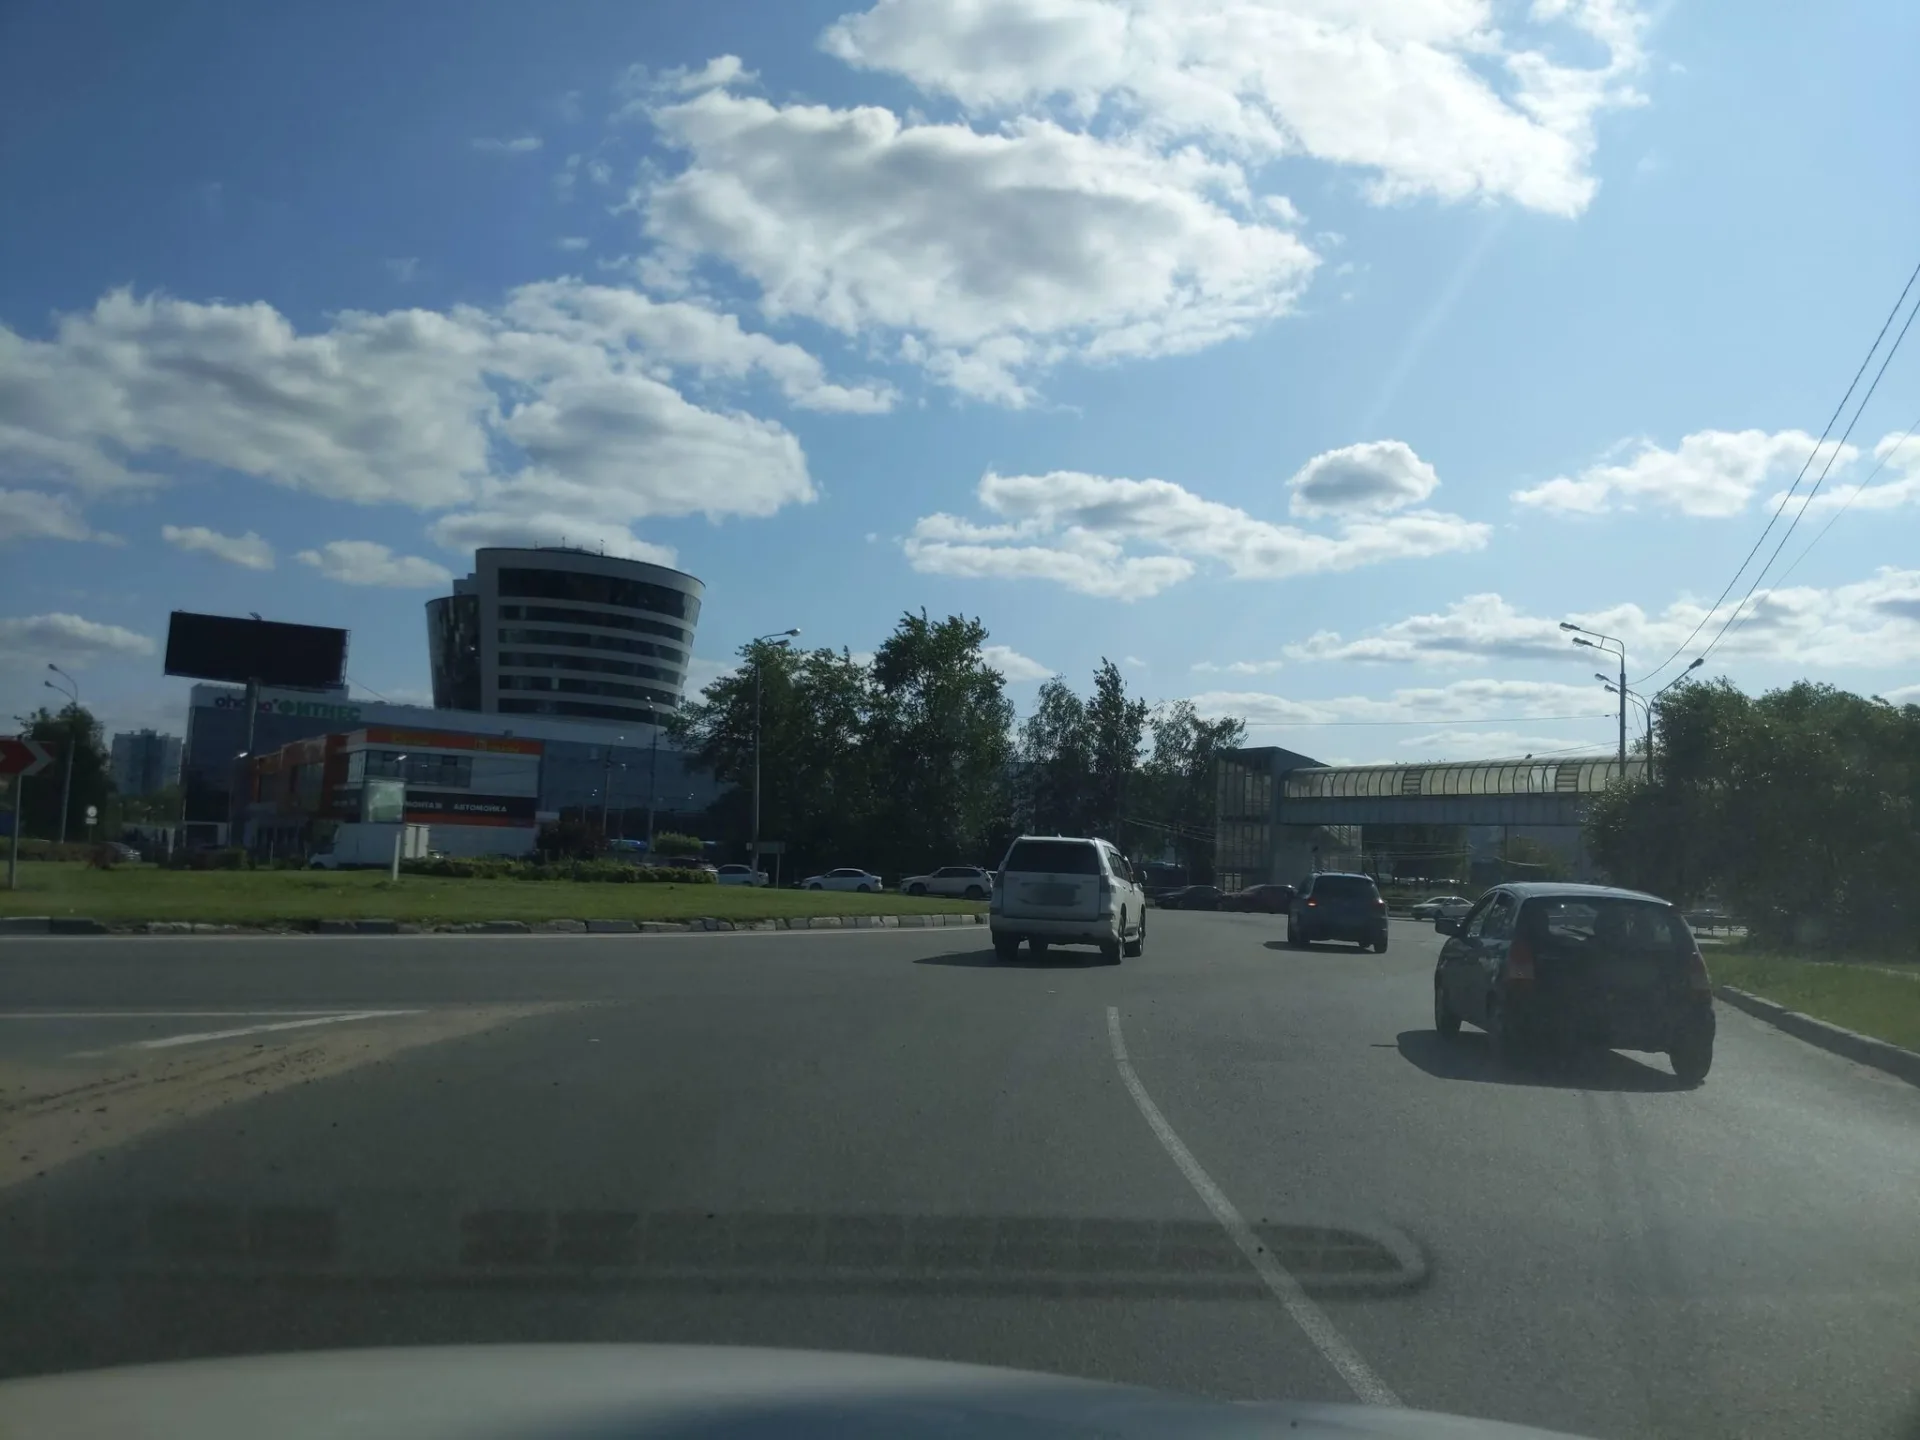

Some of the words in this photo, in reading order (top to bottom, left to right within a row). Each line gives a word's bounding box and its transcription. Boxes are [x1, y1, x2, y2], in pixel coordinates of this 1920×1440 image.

[277, 698, 363, 721] ФИТНЕС
[404, 800, 443, 810] МОНТАЖ
[453, 802, 507, 813] АВТОМОЙКА
